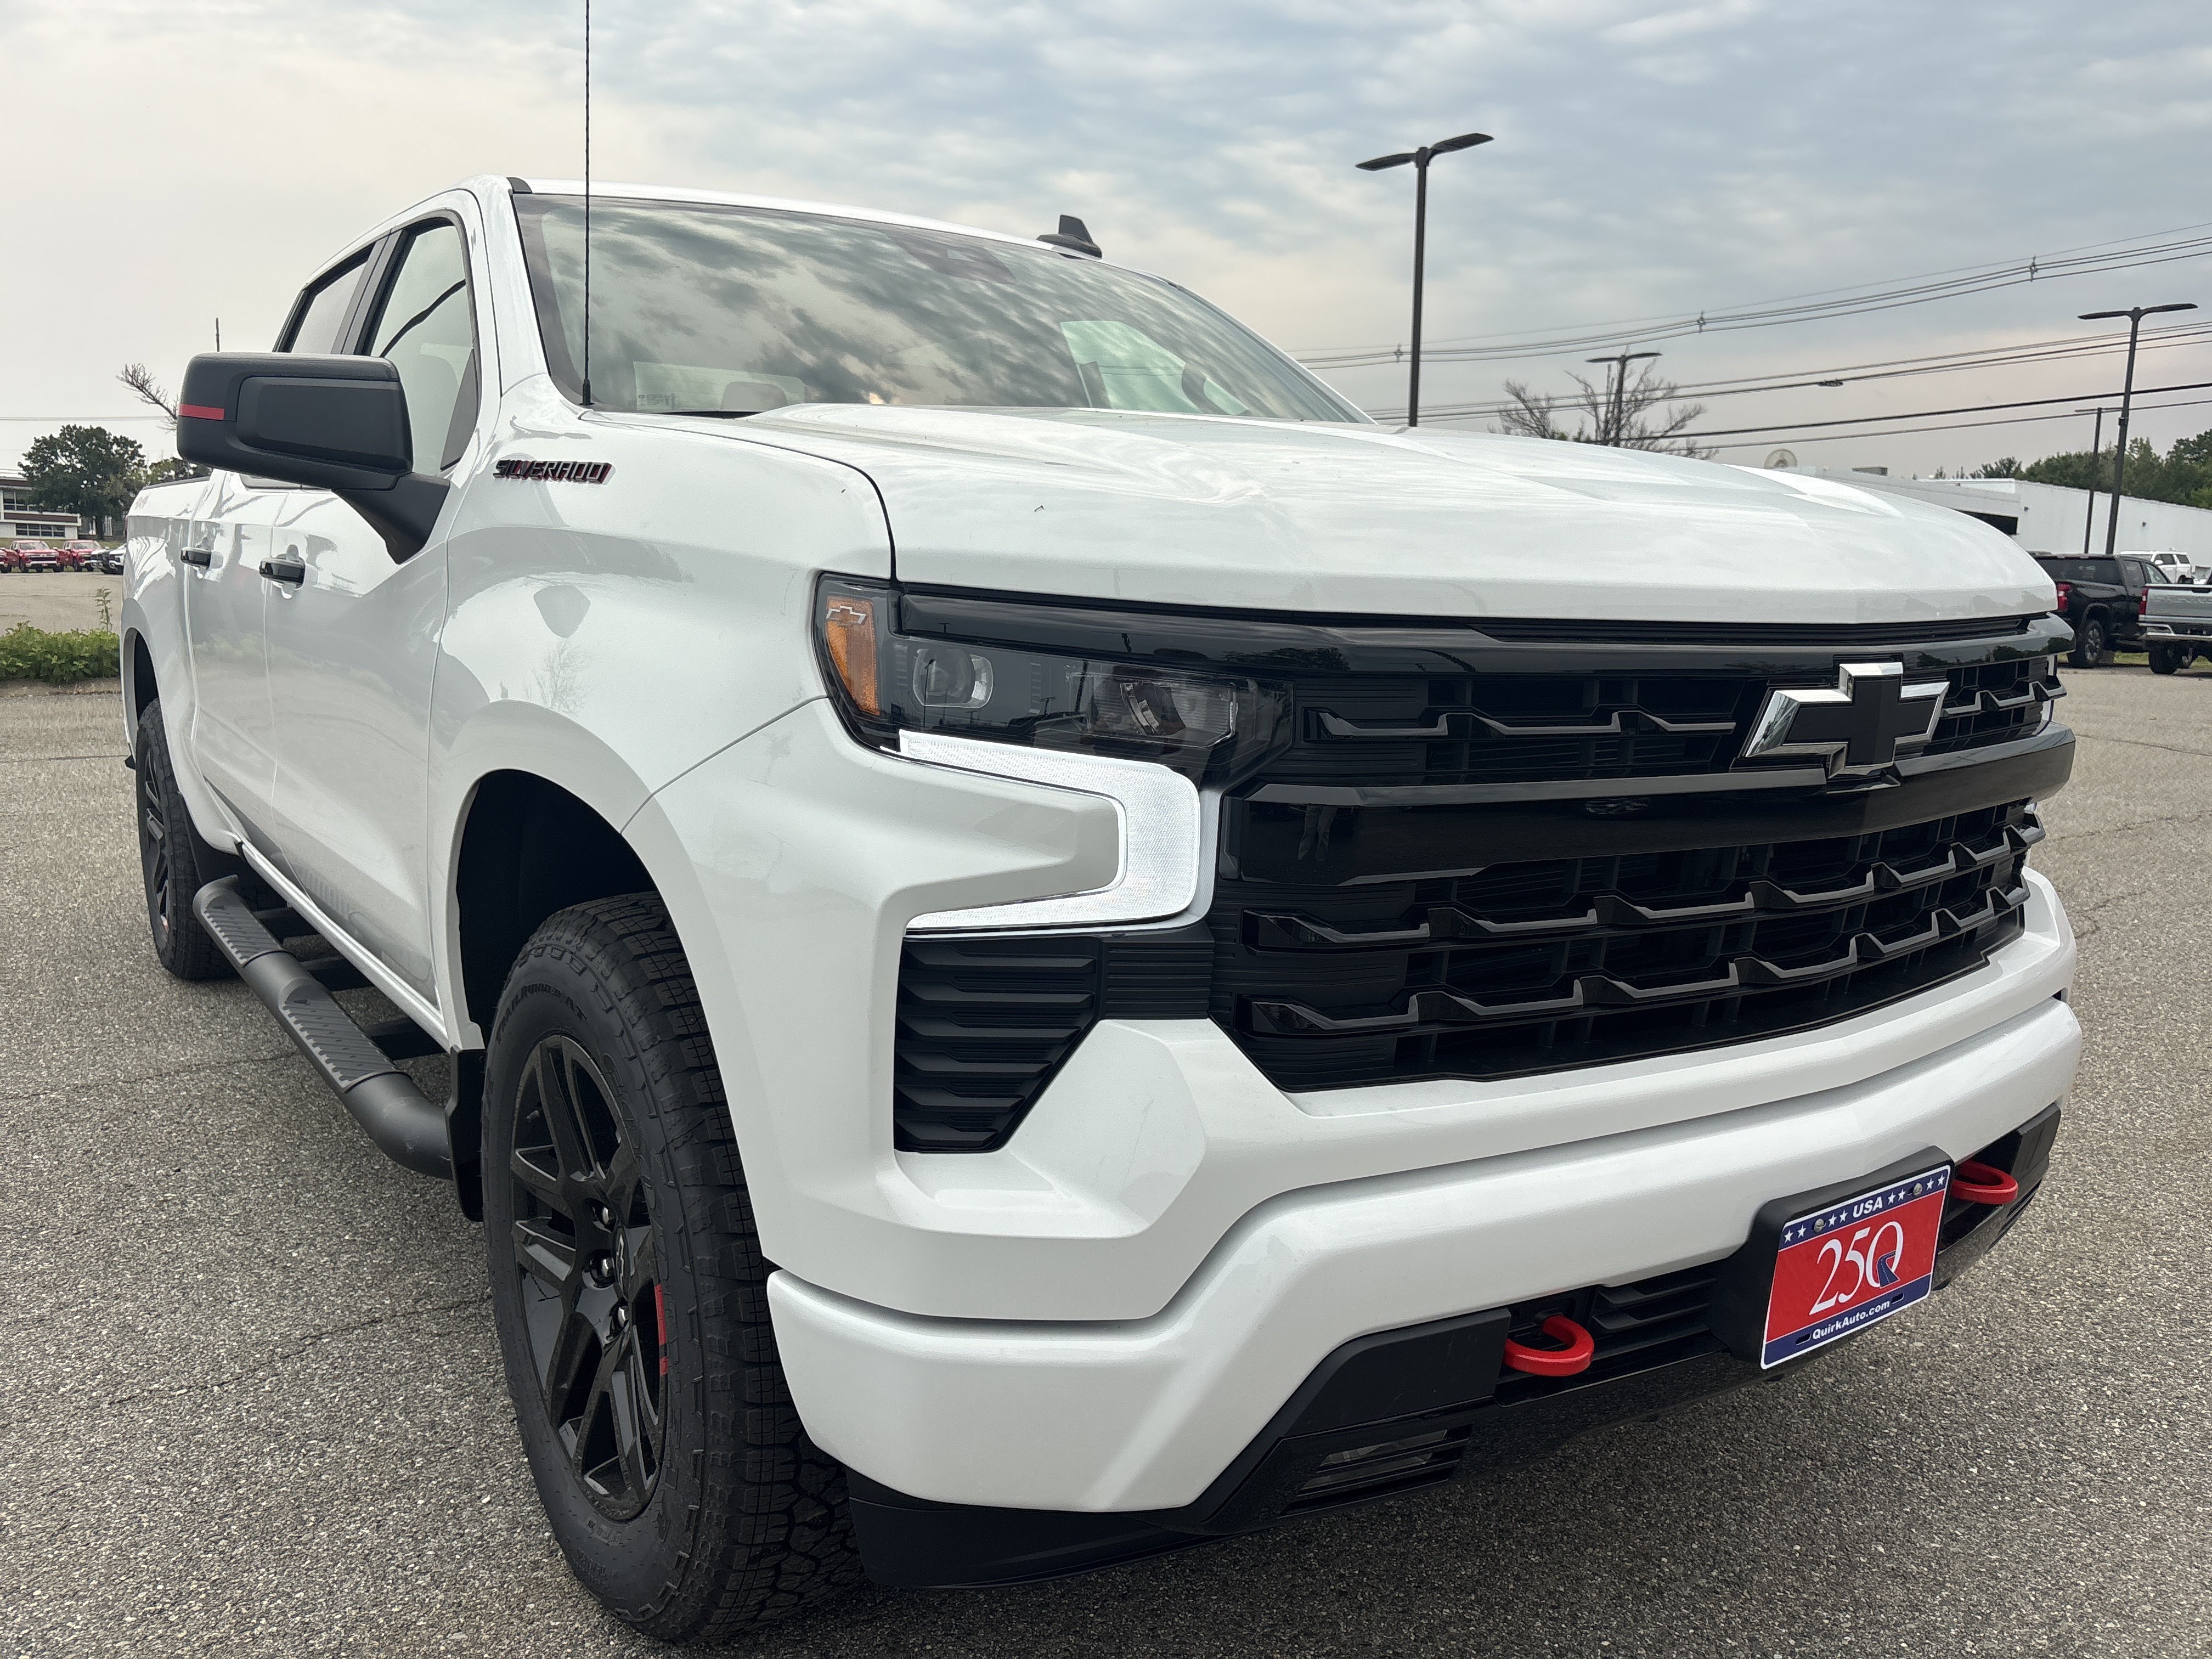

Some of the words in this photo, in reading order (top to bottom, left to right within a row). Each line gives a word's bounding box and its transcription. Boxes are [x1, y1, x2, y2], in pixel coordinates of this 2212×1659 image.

[493, 459, 612, 484] SILVERADO
[565, 995, 587, 1022] AT
[1852, 1196, 1883, 1218] USA
[1812, 1300, 1891, 1340] QuirkAuto.com
